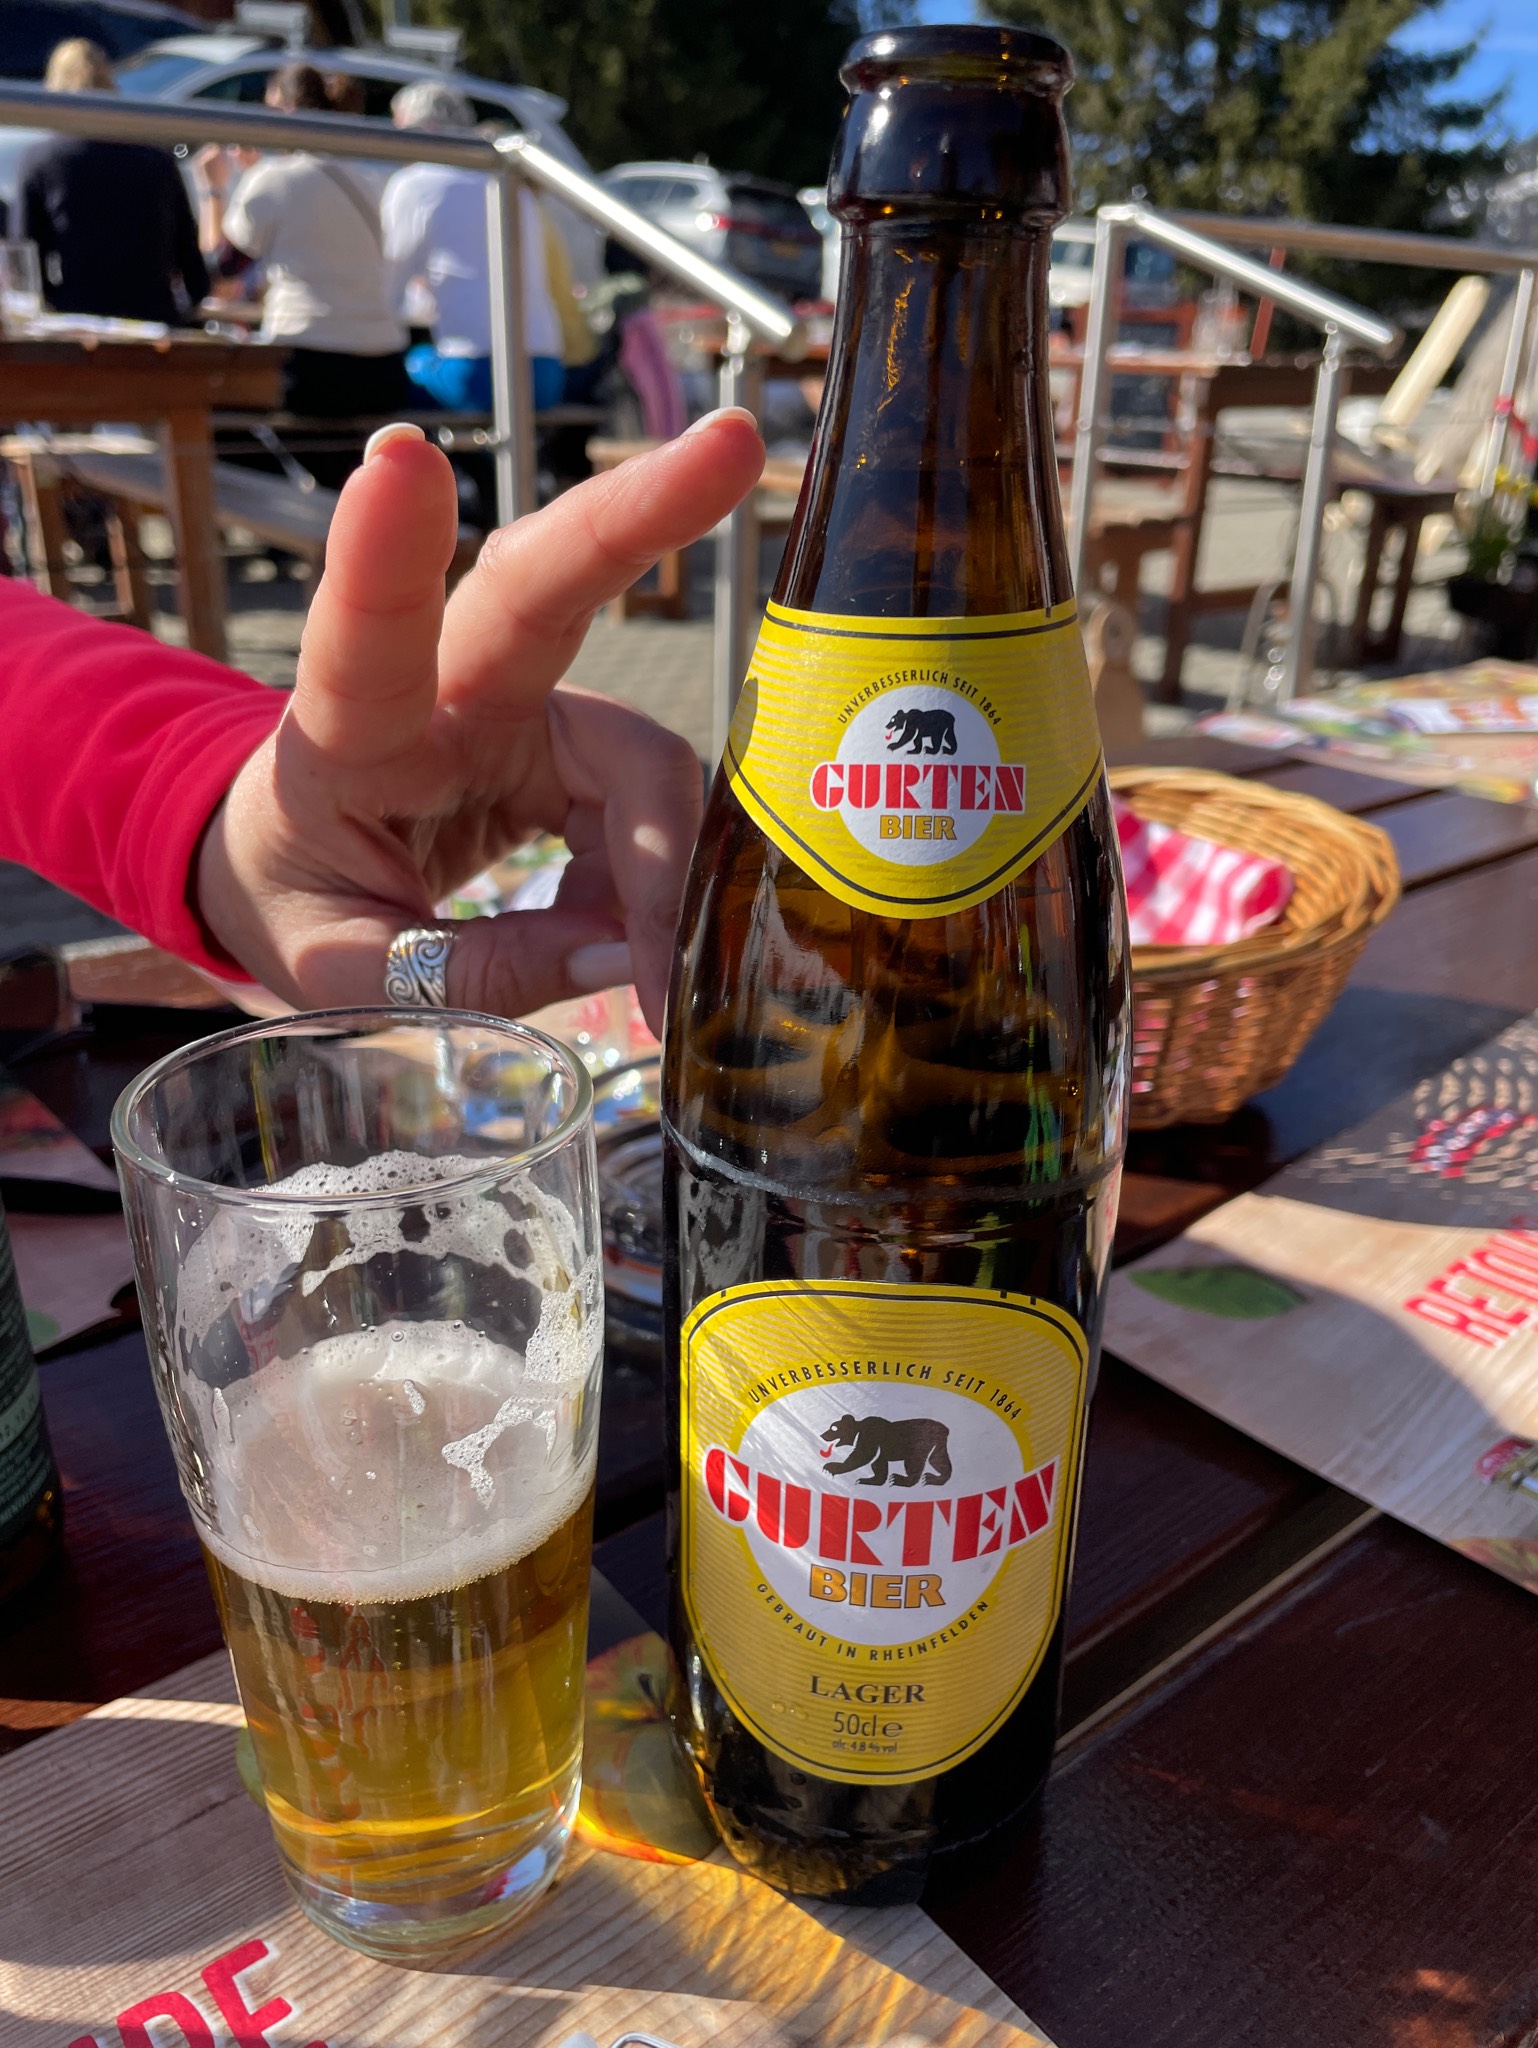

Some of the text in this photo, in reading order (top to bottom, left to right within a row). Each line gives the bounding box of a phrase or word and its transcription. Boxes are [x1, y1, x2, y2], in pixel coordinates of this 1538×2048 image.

[838, 669, 1002, 726] UNVERBESSERLICH SEIT 1864
[811, 763, 1026, 812] GURTEN
[879, 815, 958, 841] BIER
[748, 1361, 1022, 1421] UNVERBESSERLICH SEIT 1864
[704, 1448, 1057, 1567] GURTEN
[808, 1564, 946, 1609] BIER
[756, 1583, 989, 1662] GEBRAUT IN RHEINFELDEN
[809, 1674, 926, 1705] LAGER
